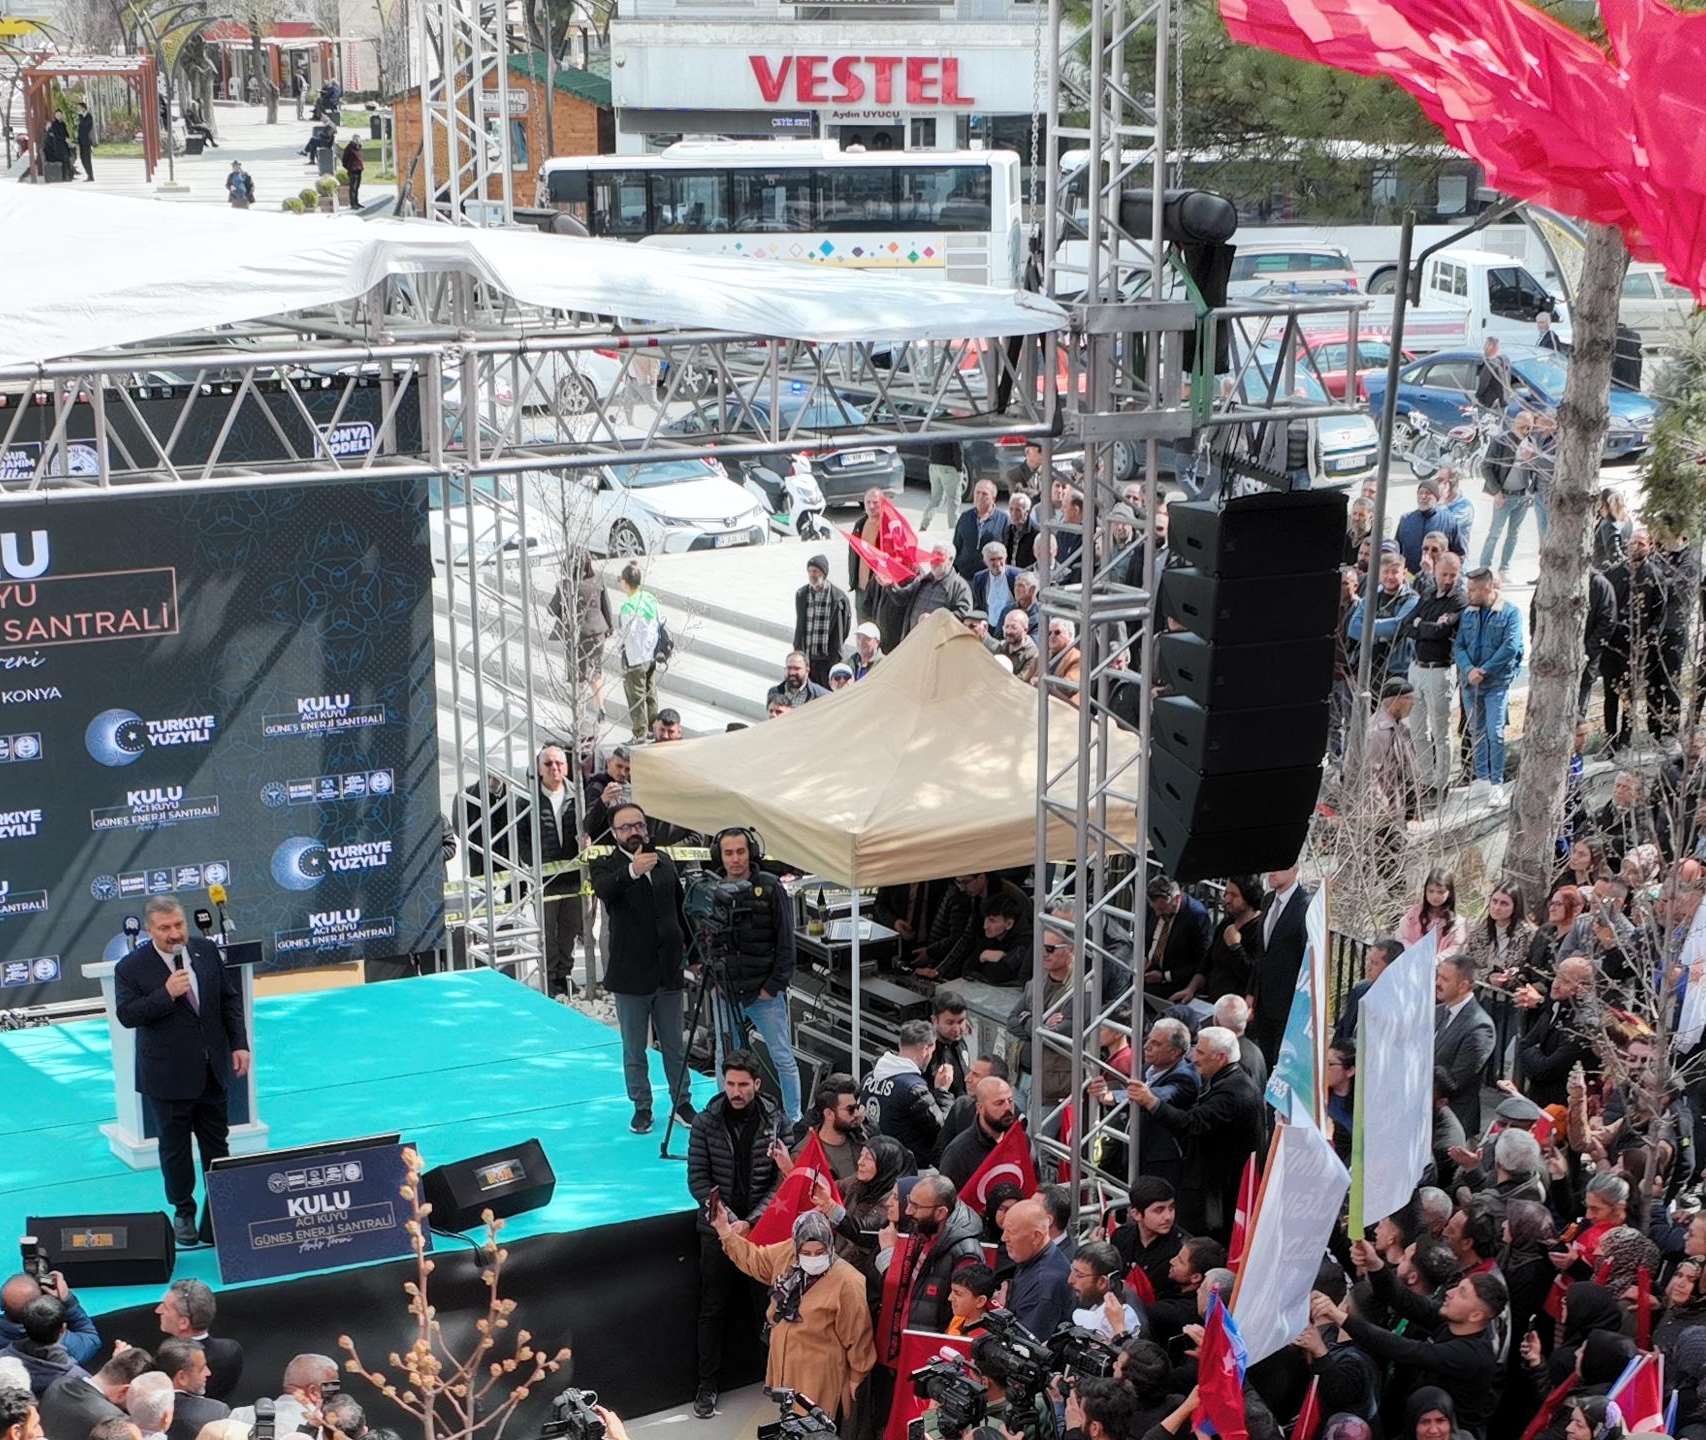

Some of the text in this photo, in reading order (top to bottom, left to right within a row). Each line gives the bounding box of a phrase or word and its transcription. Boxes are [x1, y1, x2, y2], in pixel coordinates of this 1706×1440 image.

[748, 55, 975, 105] VESTEL
[863, 111, 900, 119] UYUCU
[3, 602, 169, 642] SANTRALİ
[298, 694, 351, 713] KULU
[320, 710, 346, 719] KUYU
[127, 786, 183, 807] KULU
[151, 801, 179, 811] KUYU
[309, 908, 361, 928] KULU
[331, 923, 357, 933] KUYU
[288, 1190, 351, 1217] KULU
[296, 1211, 348, 1228] ACI KUYU
[296, 1226, 335, 1242] ENERJİ
[337, 1213, 392, 1233] SANTRALİ
